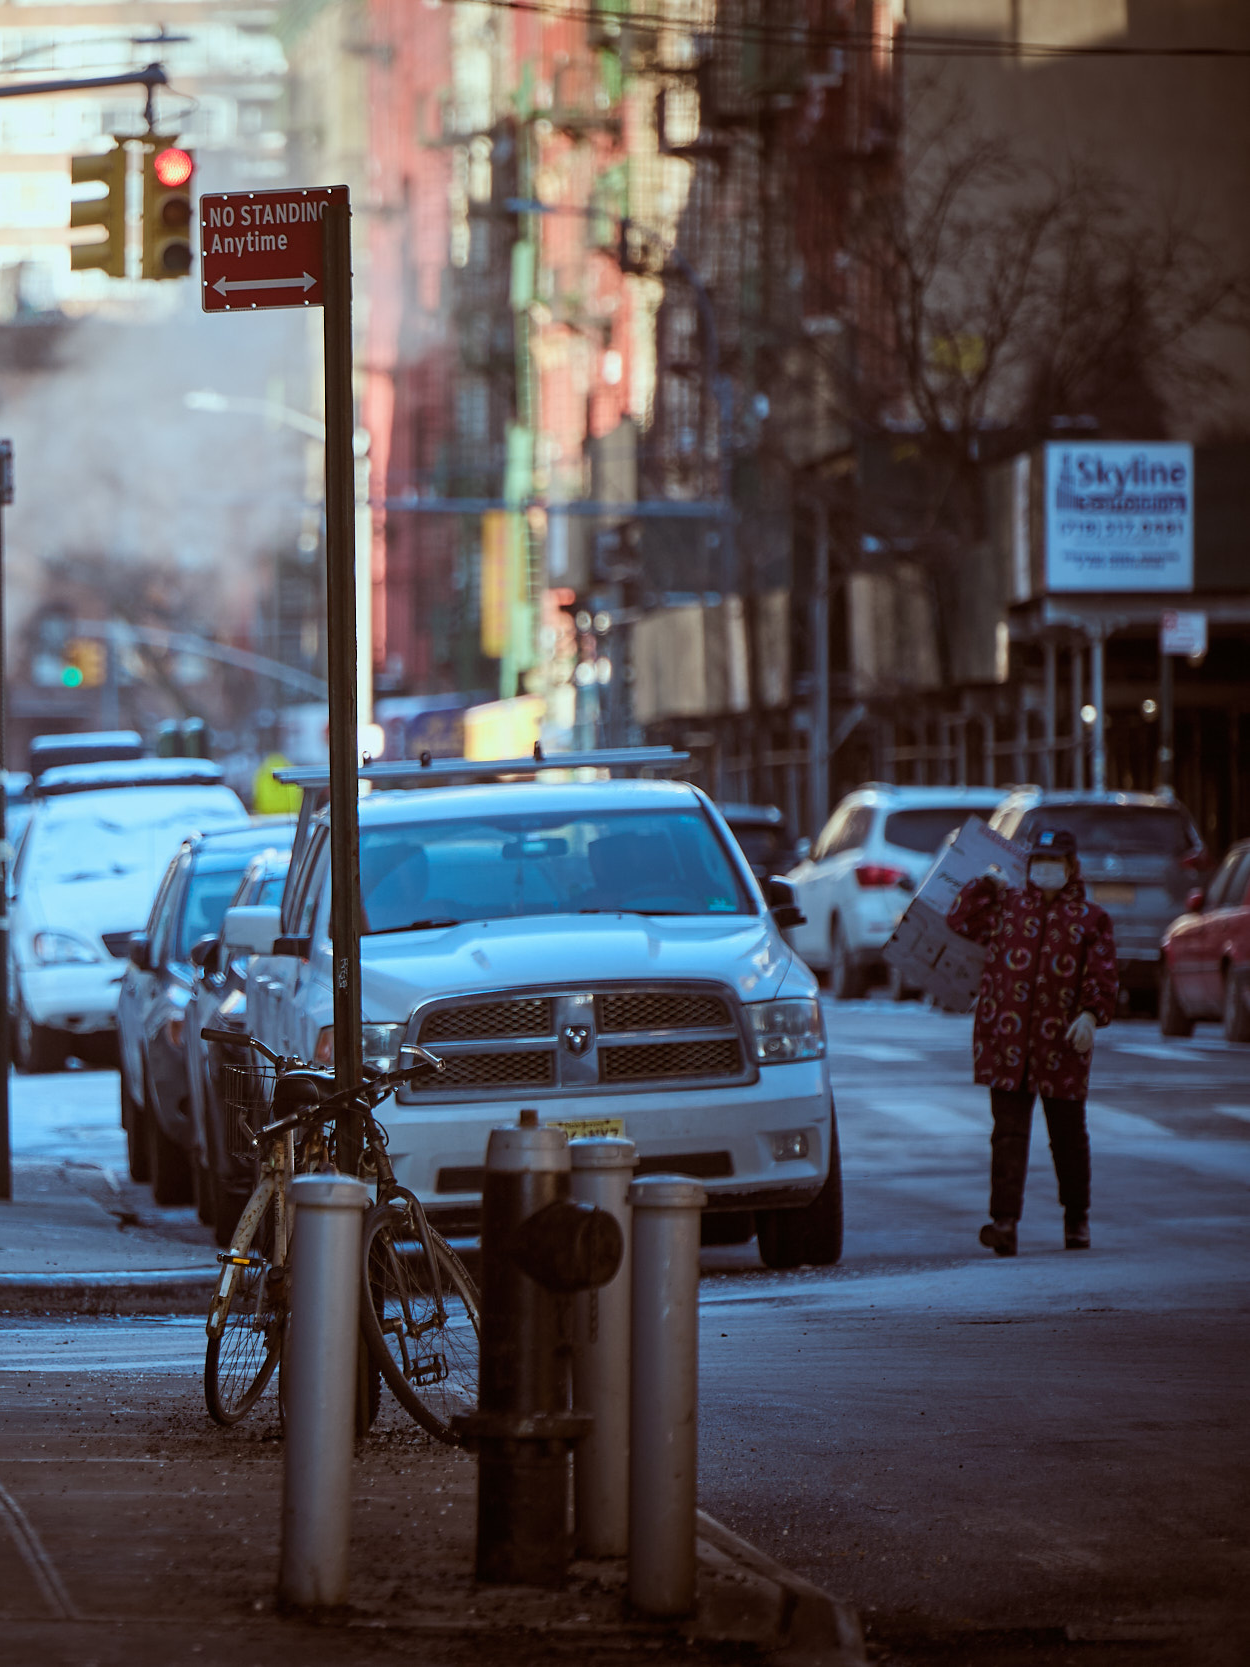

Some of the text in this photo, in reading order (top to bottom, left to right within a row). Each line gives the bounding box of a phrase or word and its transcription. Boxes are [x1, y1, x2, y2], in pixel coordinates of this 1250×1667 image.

[209, 206, 235, 228] NO
[211, 231, 288, 257] Anytime
[1076, 453, 1187, 496] Skyline
